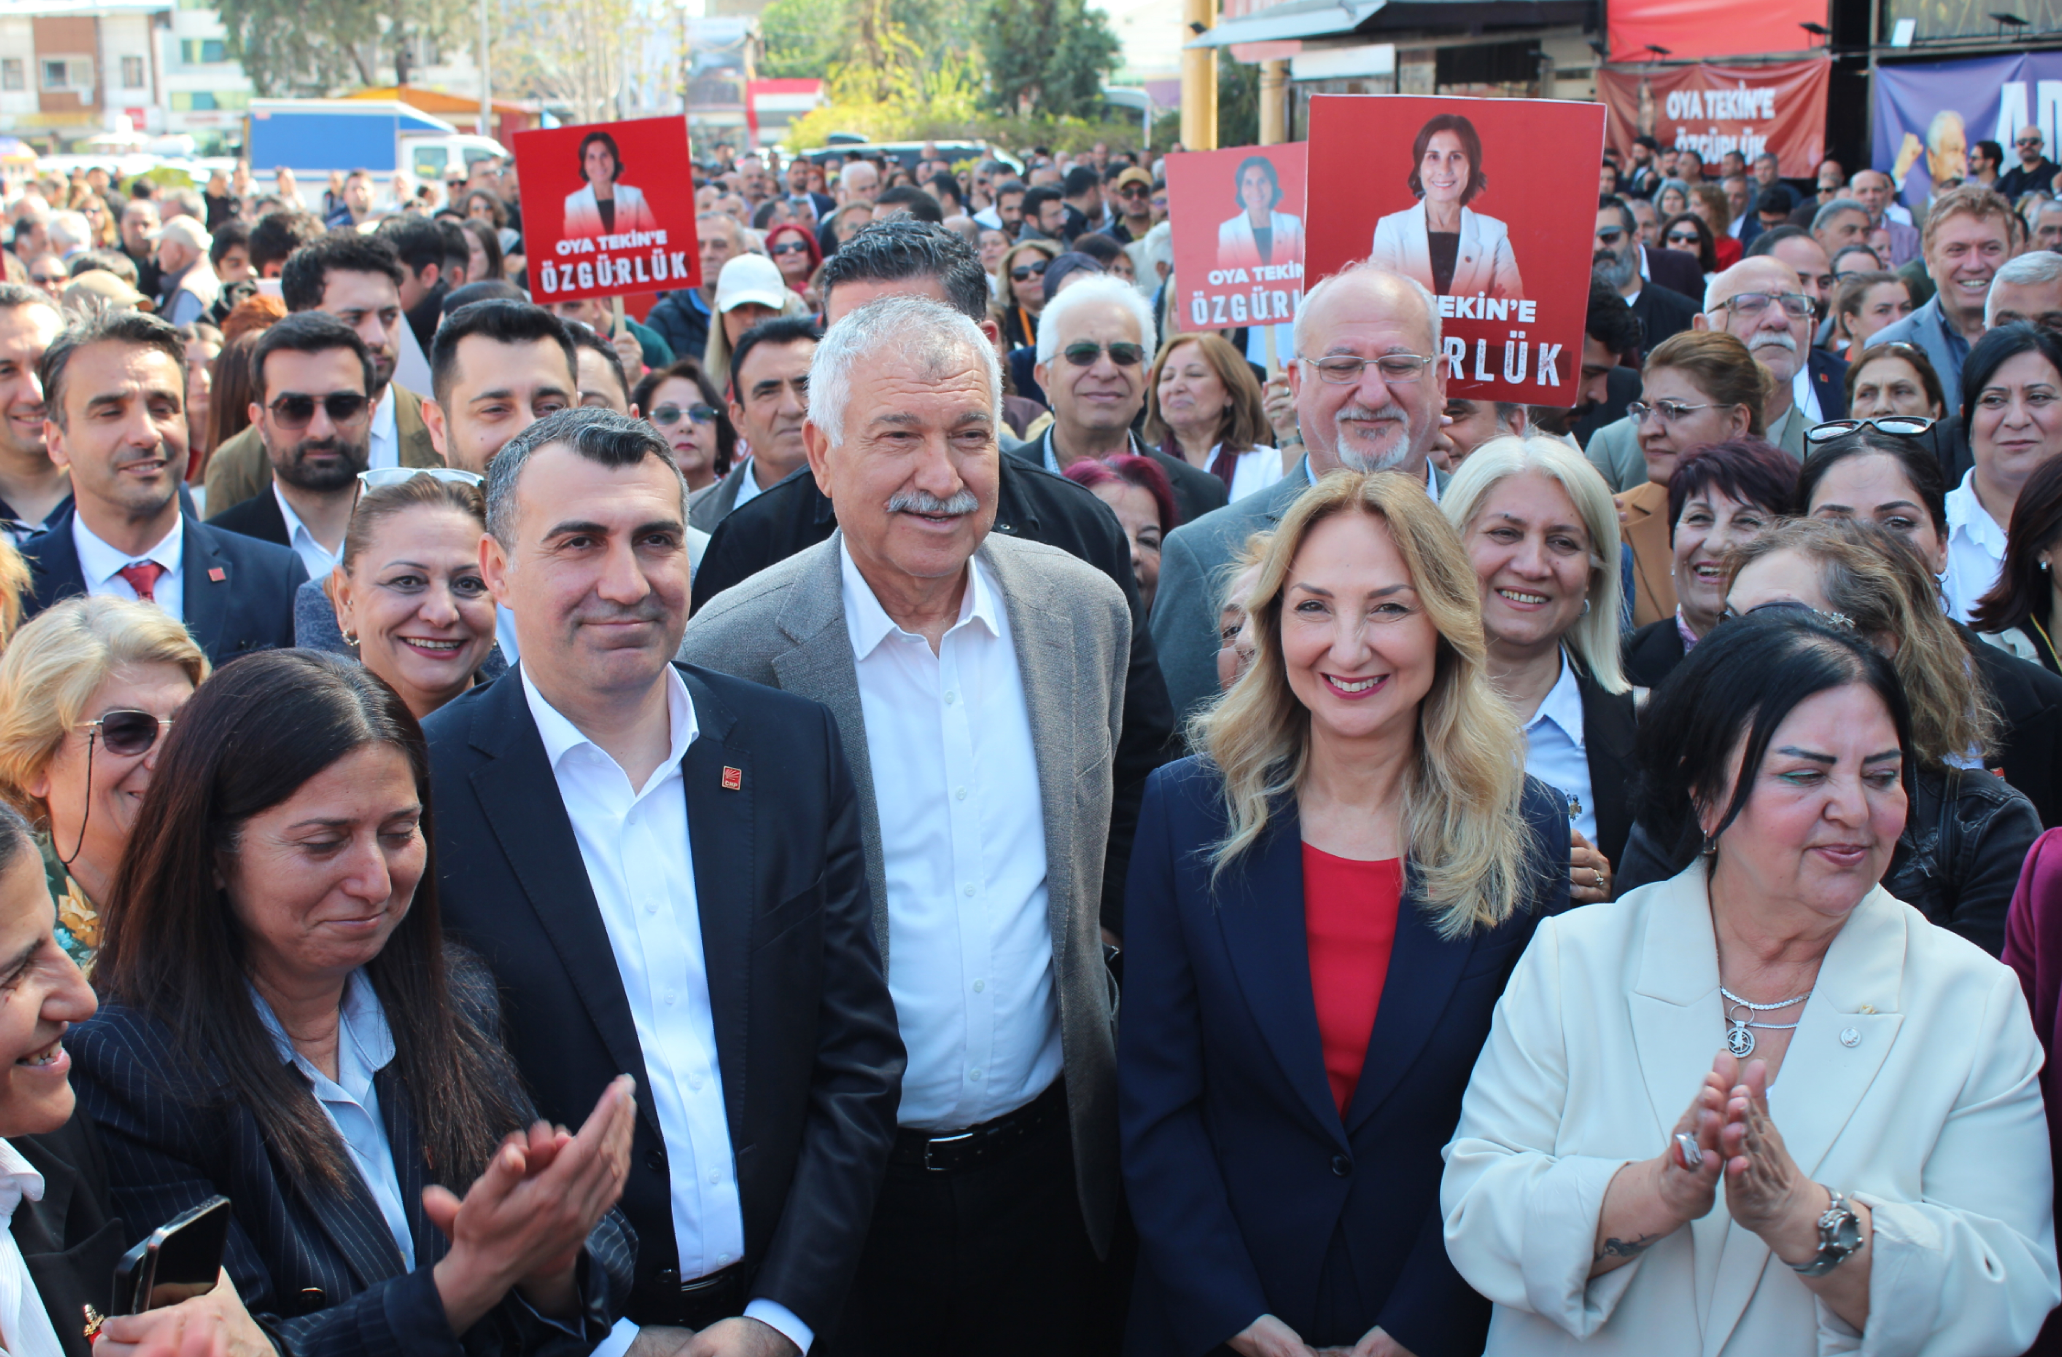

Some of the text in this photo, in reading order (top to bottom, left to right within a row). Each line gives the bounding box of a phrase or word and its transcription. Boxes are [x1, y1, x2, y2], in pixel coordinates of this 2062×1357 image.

[1666, 80, 1776, 120] OYA TEKİN'E
[556, 229, 668, 256] OYA TEKİN'E
[541, 248, 688, 294] ÖZGÜRLÜK
[1208, 259, 1304, 286] OYA TEKİN
[1435, 291, 1537, 323] EKİN'E
[1443, 330, 1563, 387] RLÜK
